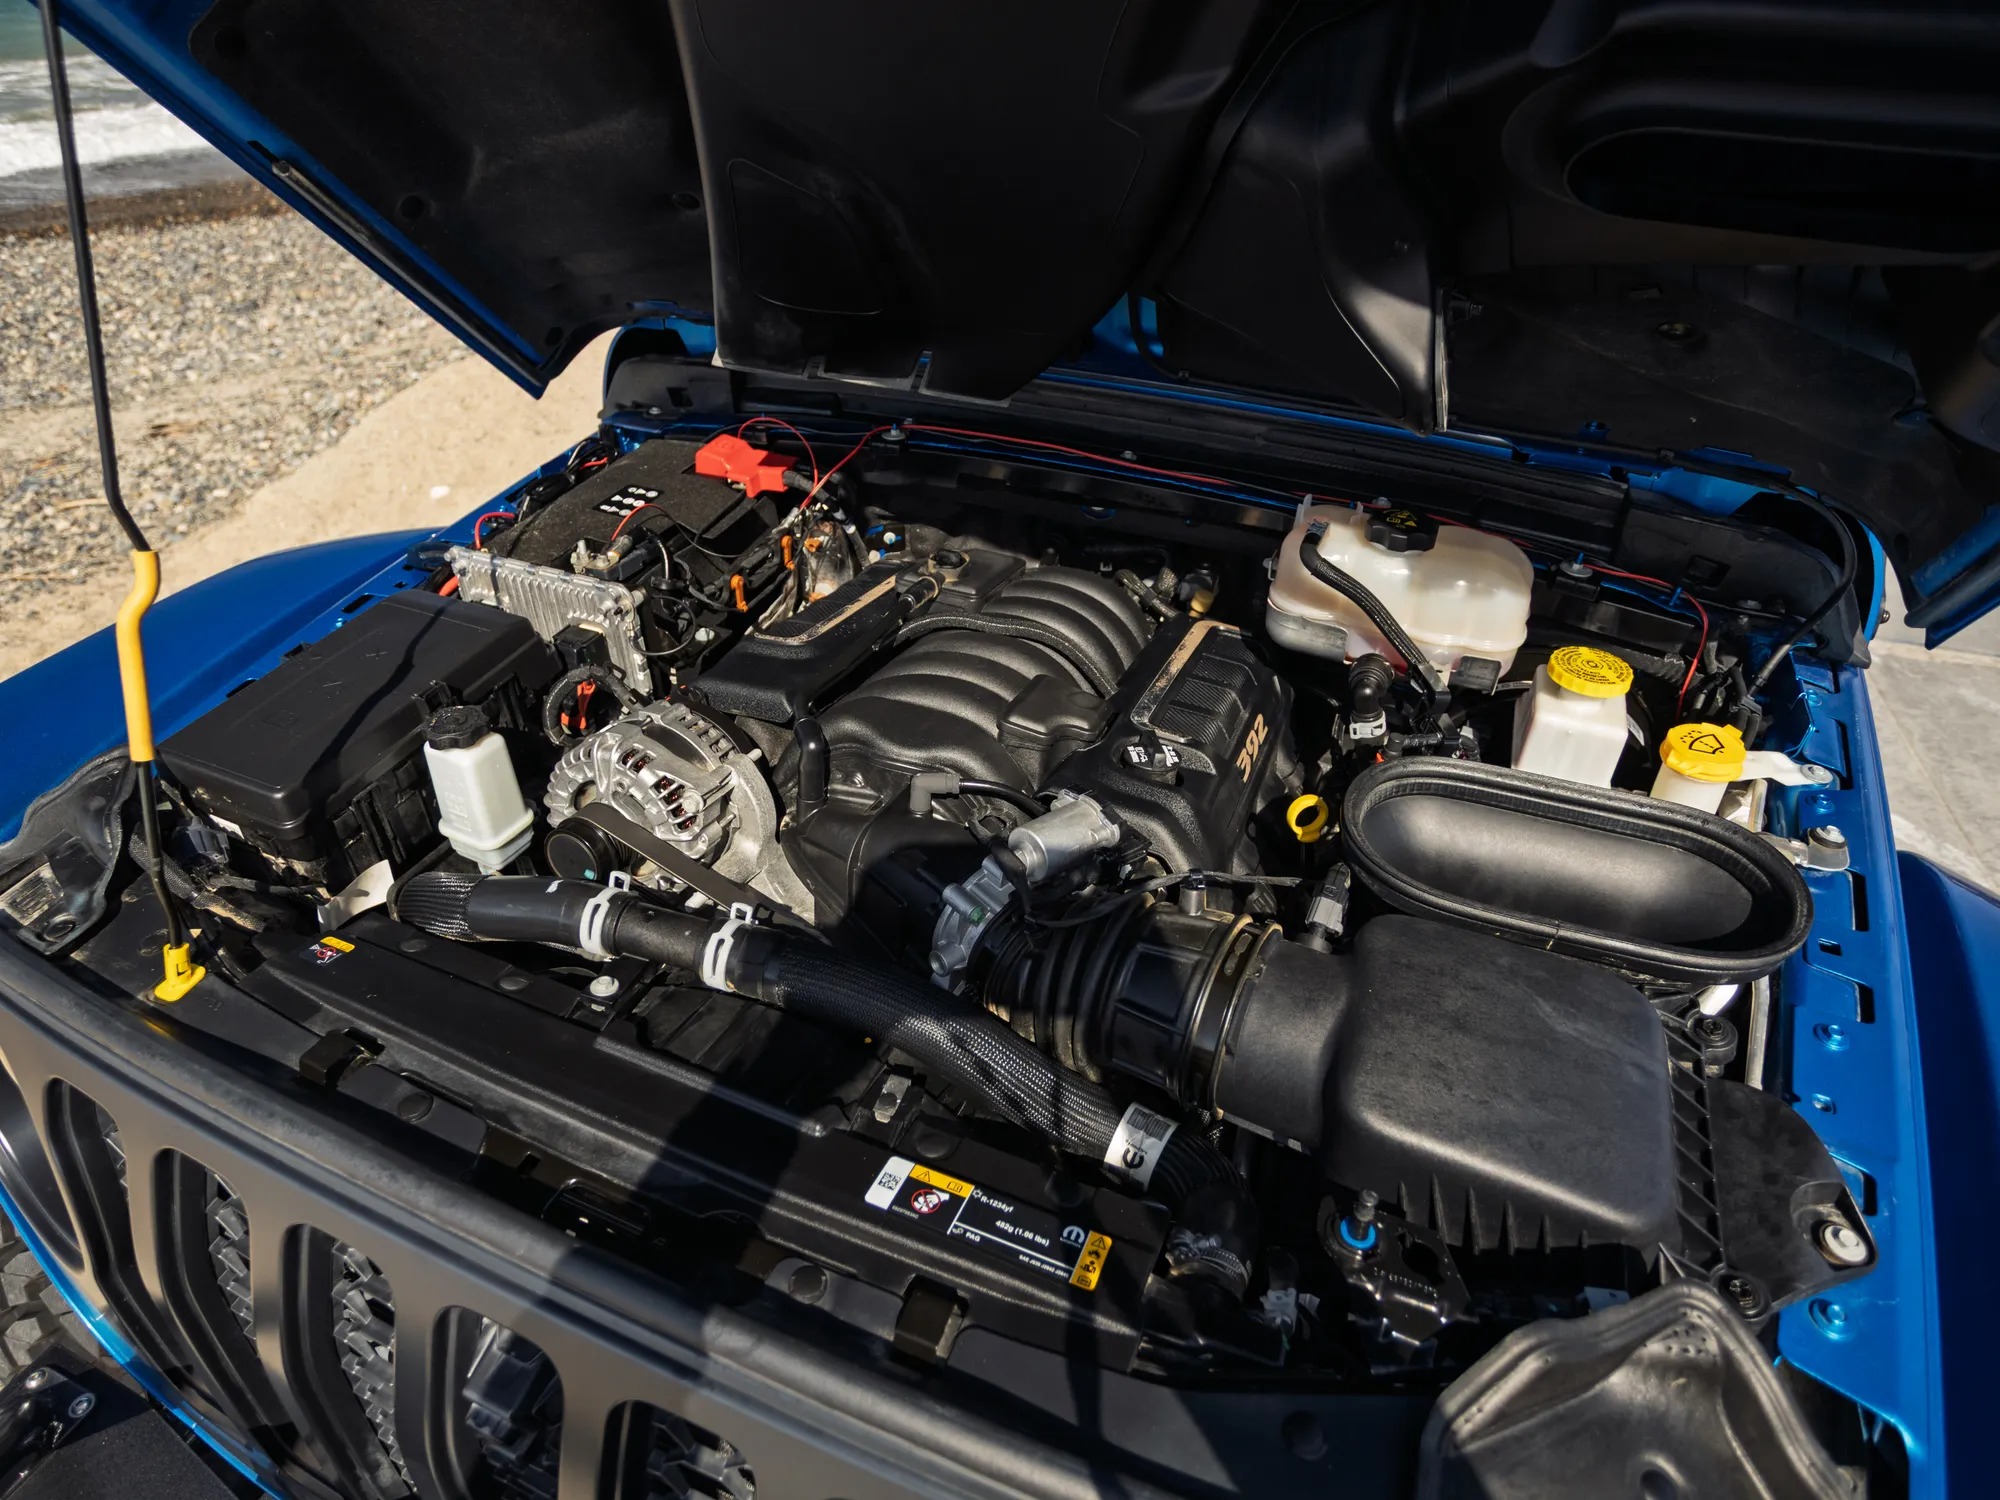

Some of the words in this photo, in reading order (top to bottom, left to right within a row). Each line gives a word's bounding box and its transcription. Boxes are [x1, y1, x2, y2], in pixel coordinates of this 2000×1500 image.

[1235, 713, 1269, 783] 392
[980, 1195, 1014, 1213] R-1234yf
[965, 1232, 981, 1242] PAG
